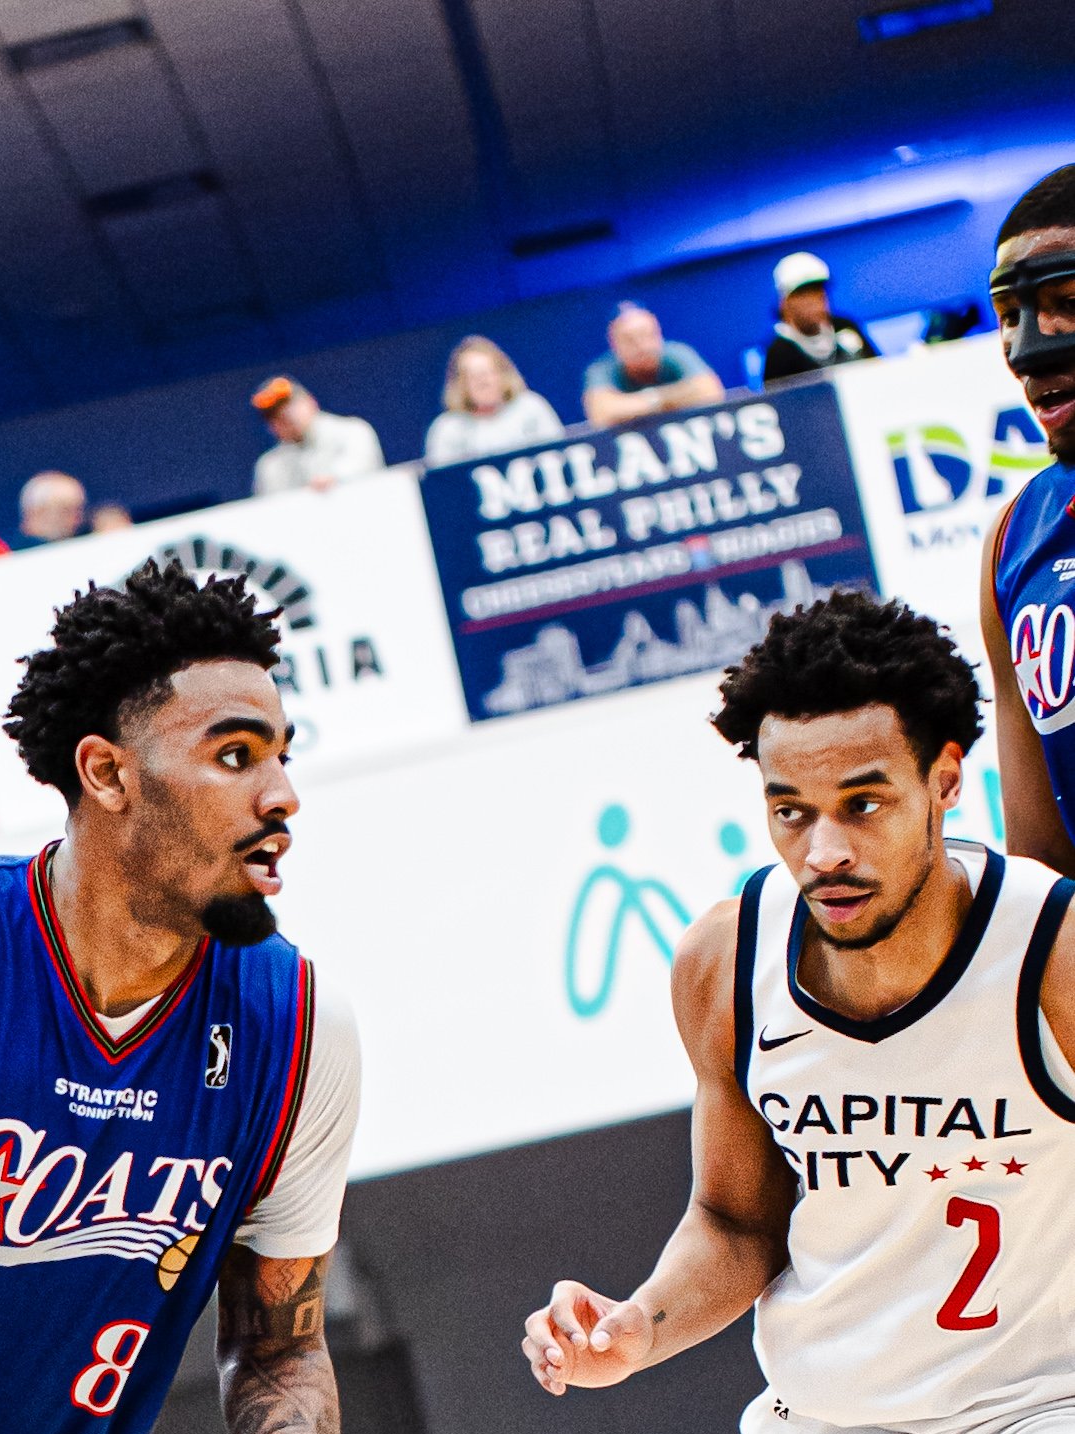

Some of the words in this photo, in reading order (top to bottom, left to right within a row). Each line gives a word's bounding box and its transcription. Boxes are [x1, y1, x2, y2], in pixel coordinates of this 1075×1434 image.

[471, 402, 786, 520] MILAN'S
[477, 508, 618, 574] REAL
[621, 463, 802, 542] PHILLY
[759, 1092, 1032, 1140] CAPITAL
[936, 1195, 1002, 1331] 2
[70, 1319, 151, 1418] 8
